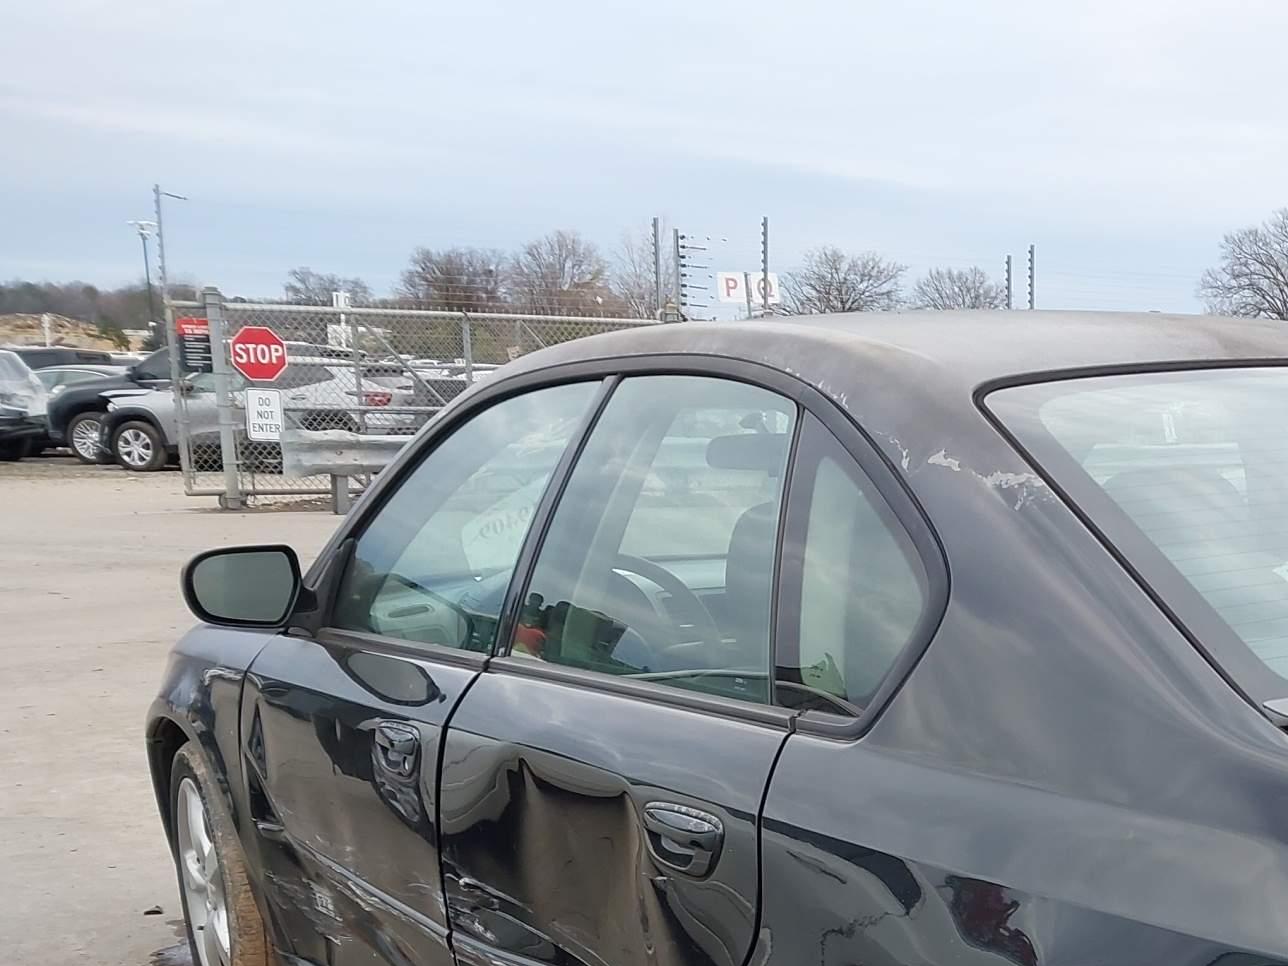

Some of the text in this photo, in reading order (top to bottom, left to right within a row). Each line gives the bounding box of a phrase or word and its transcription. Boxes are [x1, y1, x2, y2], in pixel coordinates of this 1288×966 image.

[724, 277, 738, 298] P
[757, 279, 775, 299] Q
[235, 343, 283, 364] STOP
[257, 397, 271, 407] DO
[256, 410, 274, 420] NOT
[251, 422, 281, 433] ENTER
